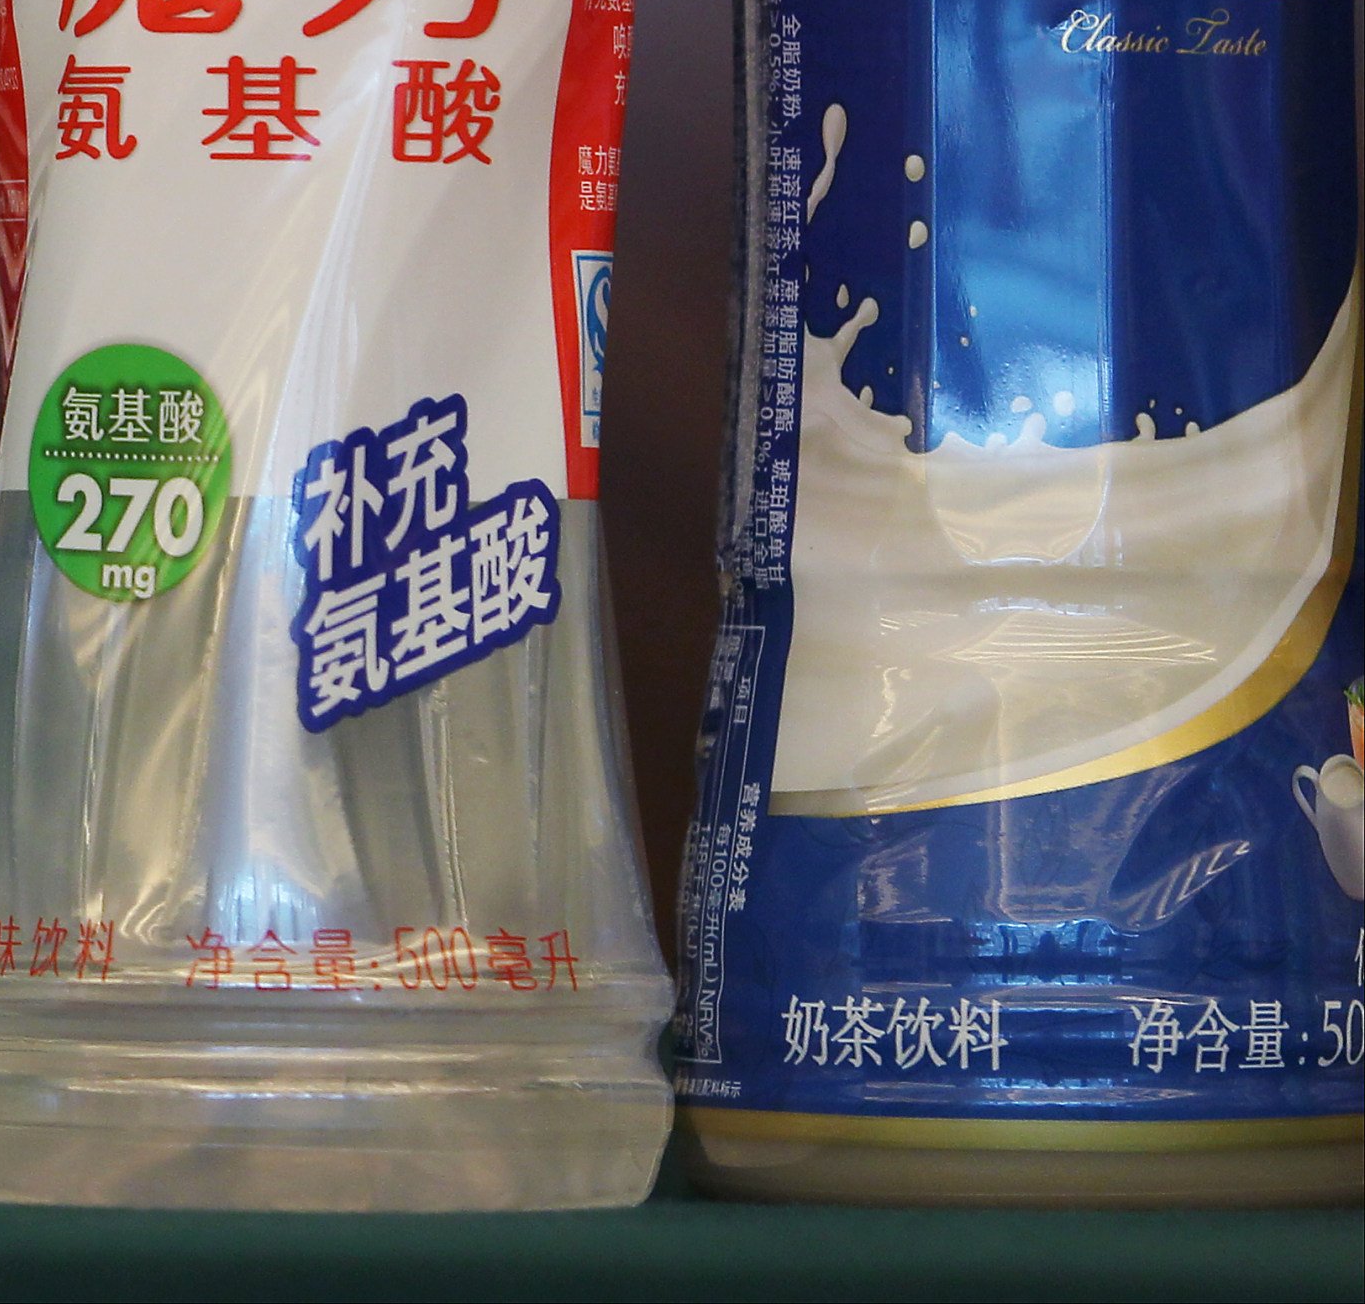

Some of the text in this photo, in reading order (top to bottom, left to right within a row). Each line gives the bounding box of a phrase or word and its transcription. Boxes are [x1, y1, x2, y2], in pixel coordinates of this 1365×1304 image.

[1051, 8, 1268, 57] Classic Taste
[56, 54, 502, 166] 氨基酸
[61, 386, 205, 445] 氨基酸
[56, 473, 205, 559] 270
[304, 411, 458, 582] 补充
[102, 562, 156, 599] mg
[304, 496, 552, 717] 氨基酸
[728, 781, 762, 912] 营养成分表
[185, 925, 580, 993] 净含量:500毫升
[781, 994, 1009, 1072] 奶茶饮料
